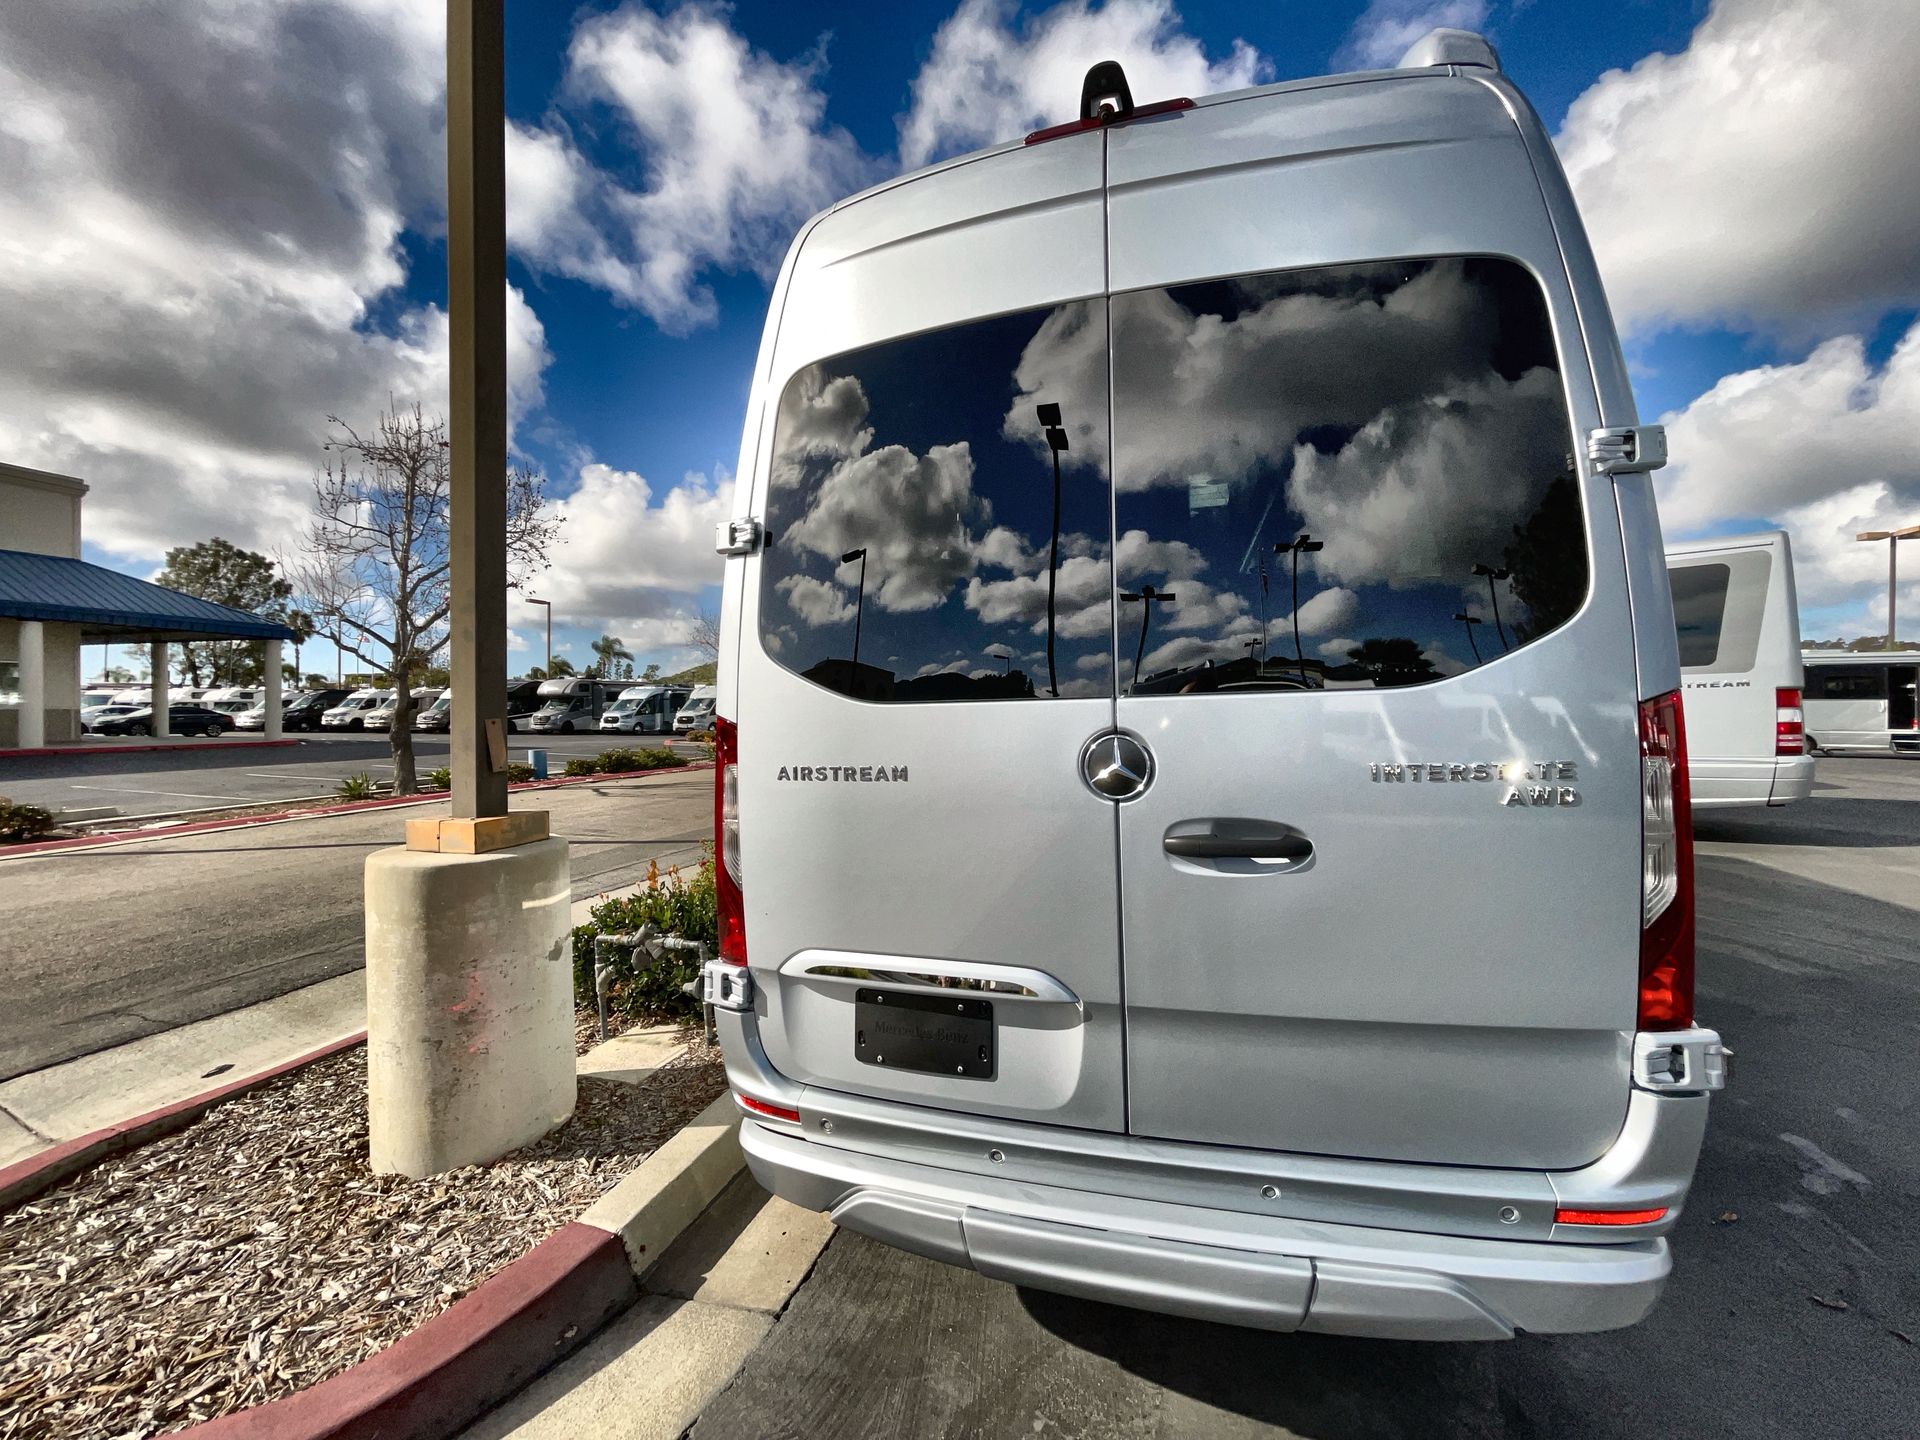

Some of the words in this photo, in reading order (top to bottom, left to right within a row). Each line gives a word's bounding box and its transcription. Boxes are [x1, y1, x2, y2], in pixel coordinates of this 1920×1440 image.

[1680, 680, 1750, 689] TREAM
[777, 765, 909, 782] AIRSTREAM
[1501, 785, 1579, 807] AWD
